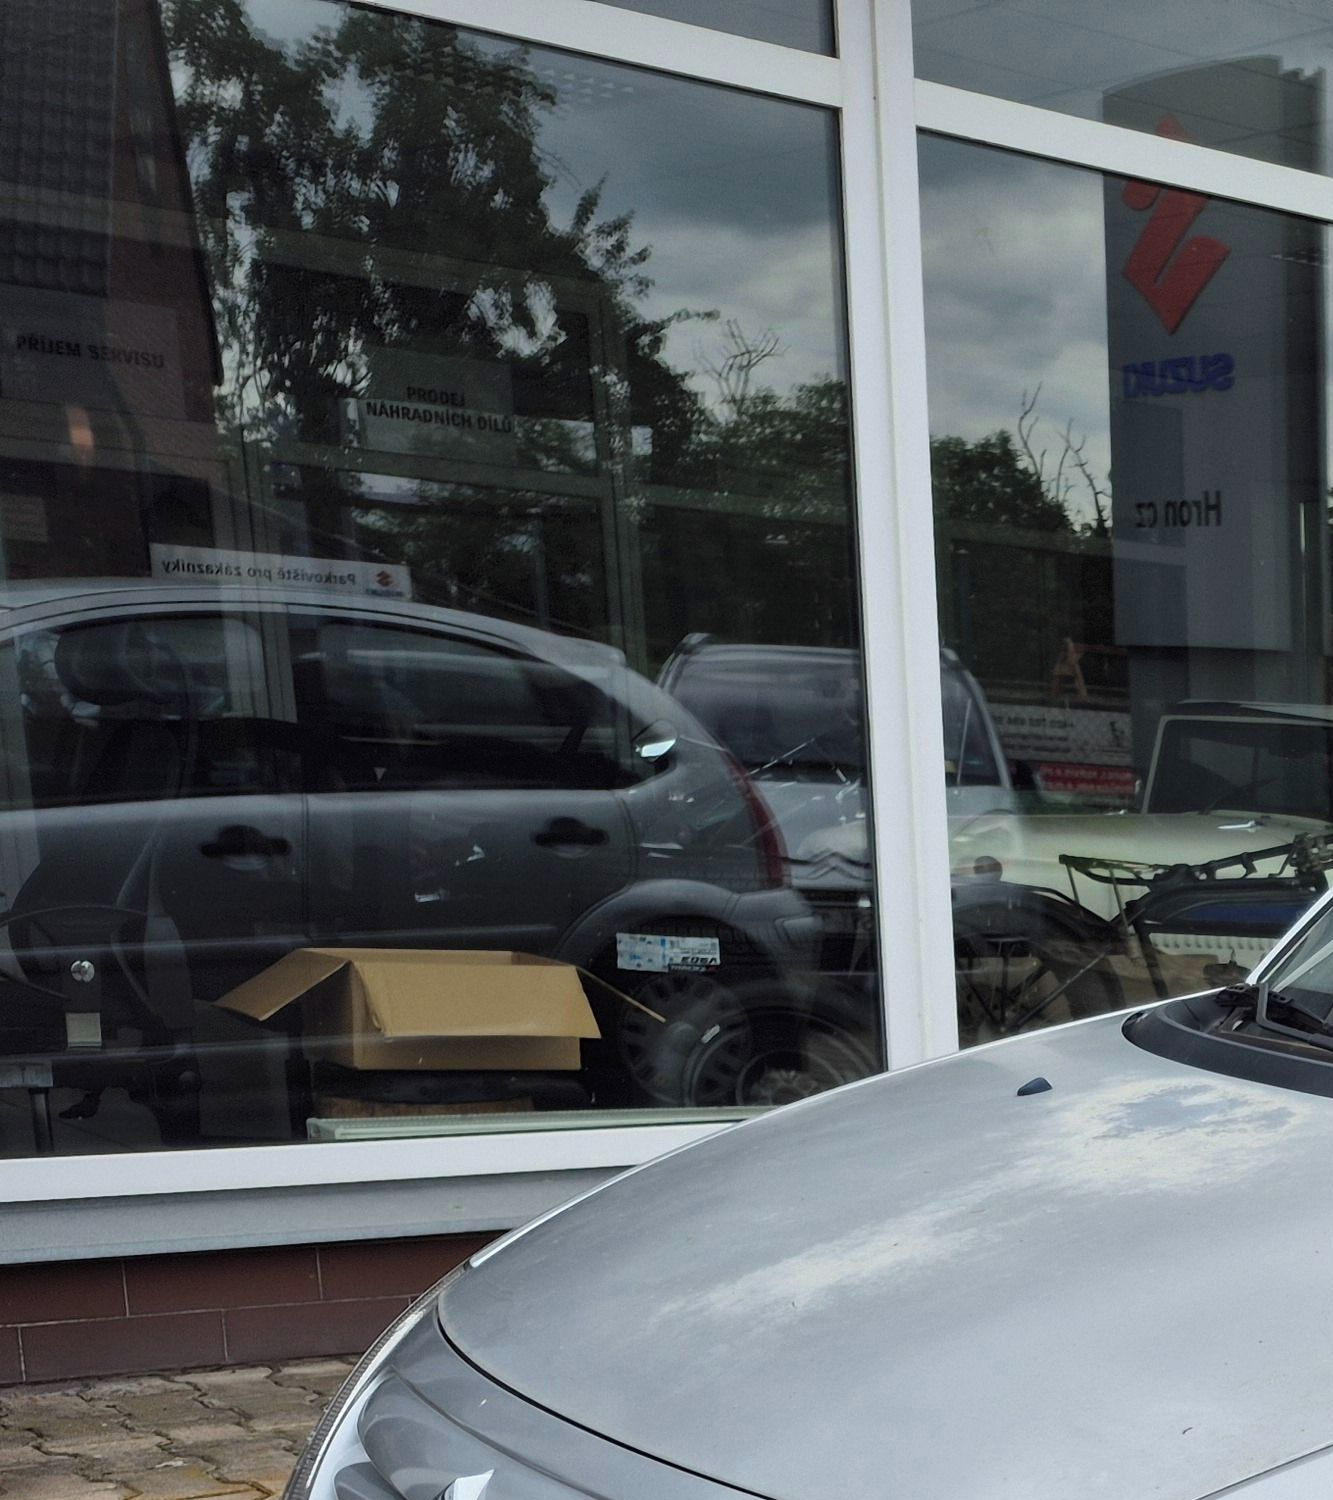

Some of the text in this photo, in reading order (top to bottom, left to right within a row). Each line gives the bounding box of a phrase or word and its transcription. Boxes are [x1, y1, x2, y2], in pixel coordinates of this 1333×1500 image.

[87, 344, 165, 369] SERVISU
[406, 386, 465, 407] PRODEJ
[366, 400, 472, 428] NÁHRADNÍCH
